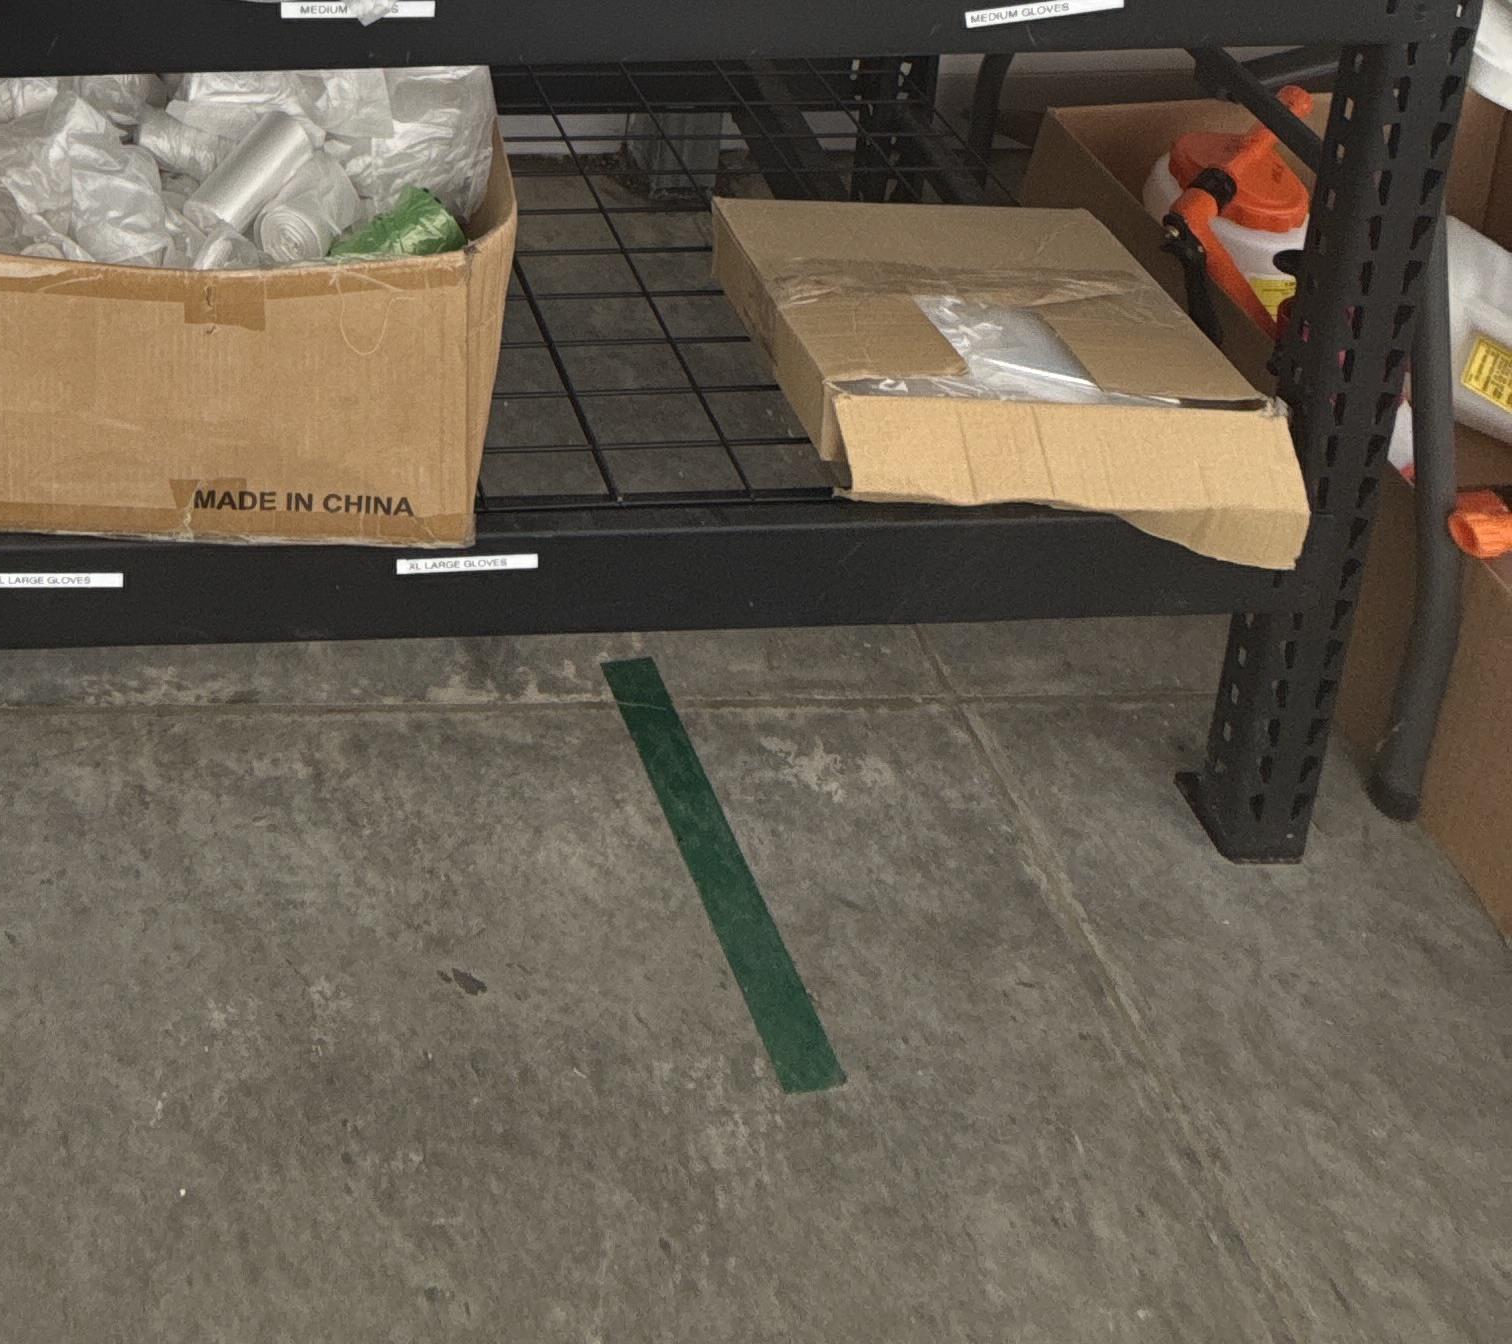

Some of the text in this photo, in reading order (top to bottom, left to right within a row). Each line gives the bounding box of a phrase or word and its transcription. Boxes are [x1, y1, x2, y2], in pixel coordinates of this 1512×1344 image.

[300, 5, 348, 14] MEDIUM
[970, 3, 1070, 24] MEDIUM GLOVES
[193, 490, 415, 518] MADE IN CHINA
[409, 558, 508, 571] XL LARGE GLOVES
[8, 576, 44, 584] LARGE
[47, 576, 91, 584] GLOVES
